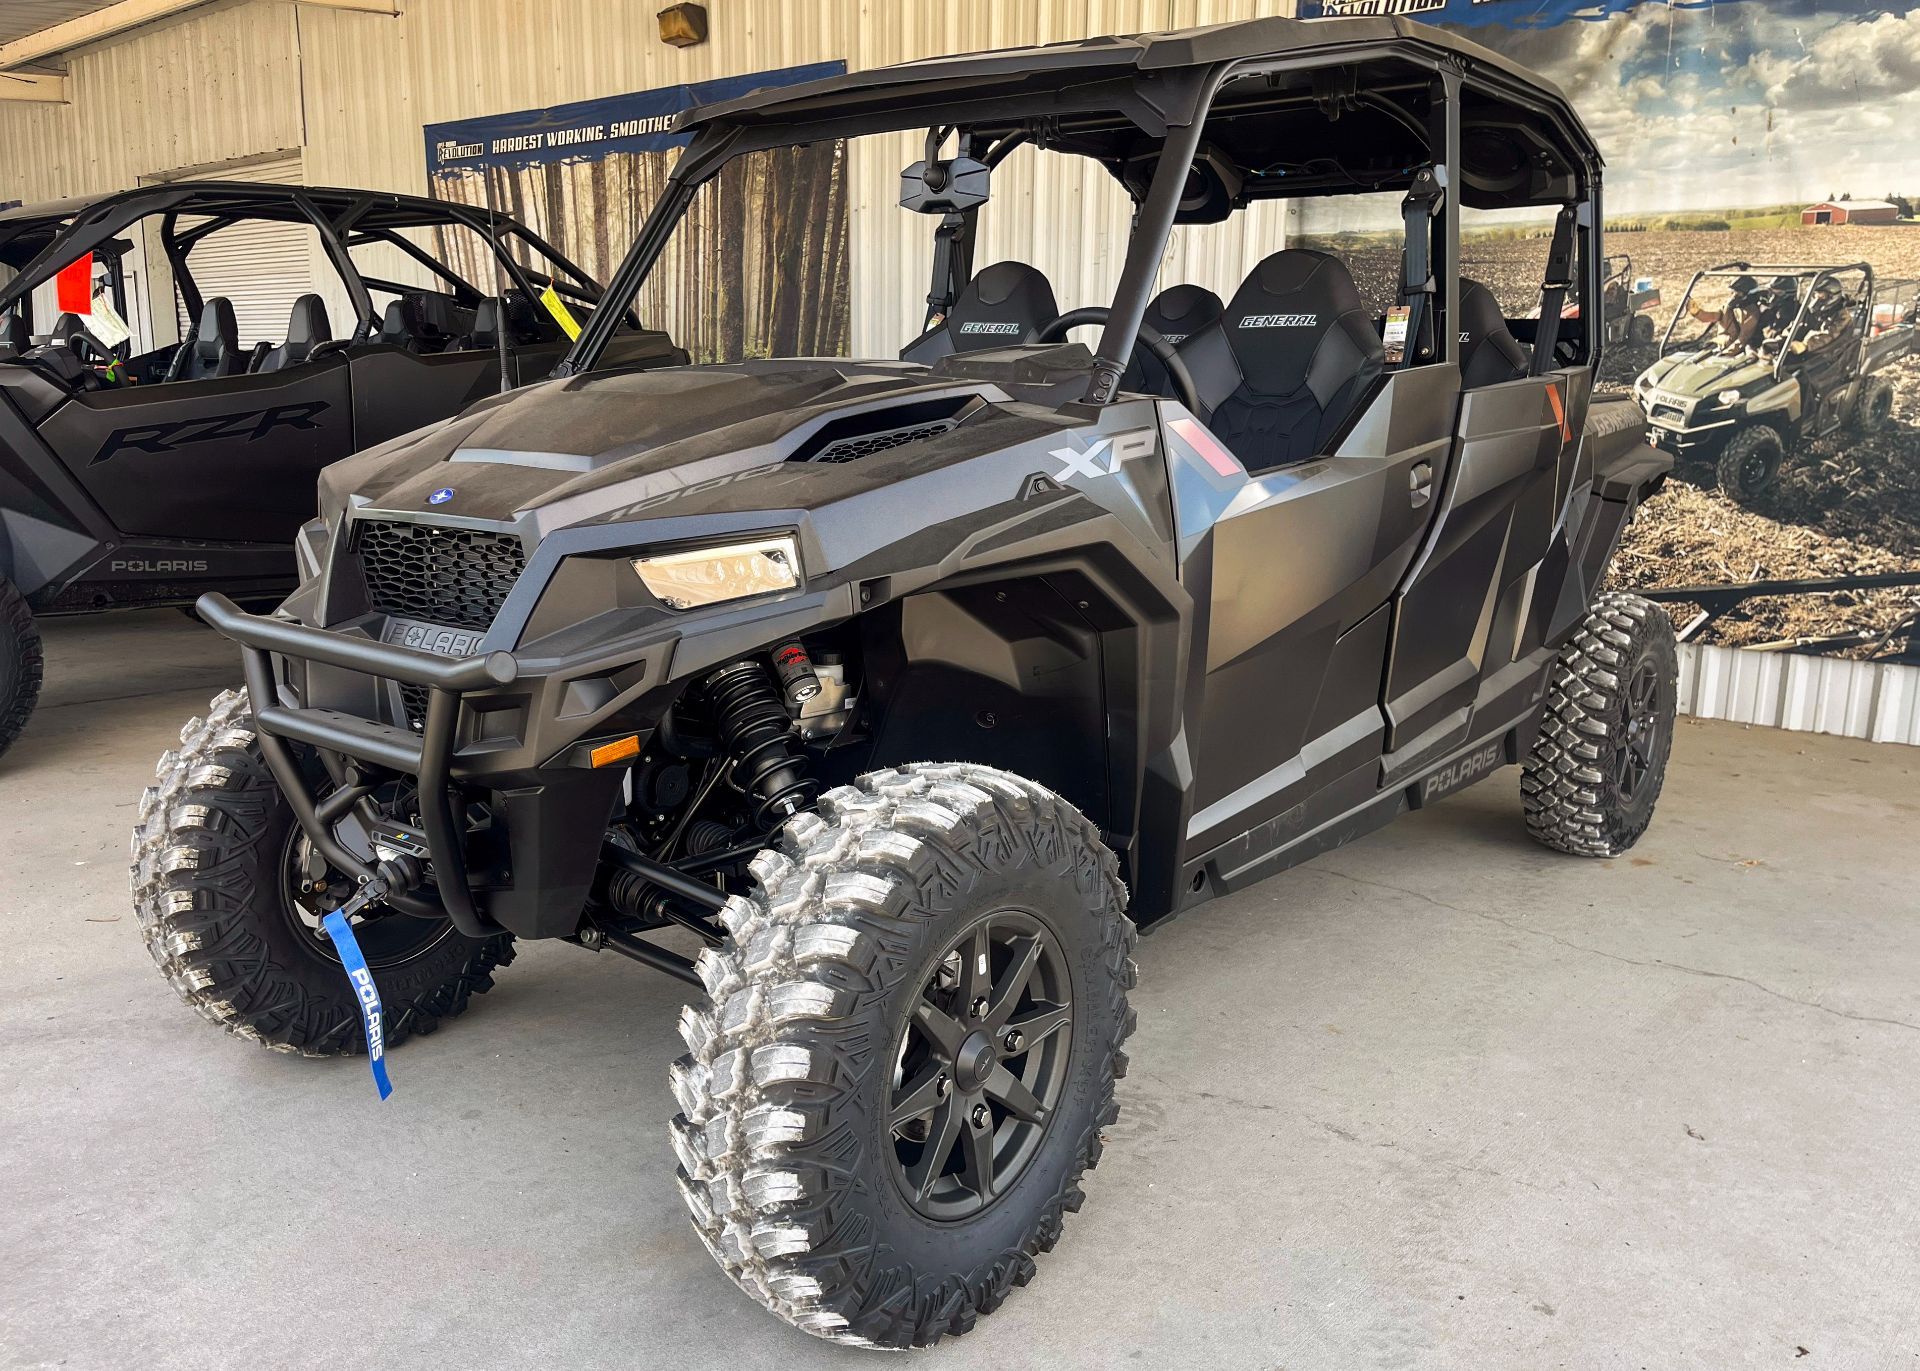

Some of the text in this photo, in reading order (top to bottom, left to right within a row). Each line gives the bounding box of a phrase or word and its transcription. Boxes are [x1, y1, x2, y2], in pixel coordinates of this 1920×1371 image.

[437, 143, 484, 165] REVOLUTION
[492, 133, 543, 154] HARDEST
[547, 125, 607, 147] WORKING.
[960, 322, 1019, 335] GENERAL
[1239, 315, 1317, 328] GENERAL
[88, 401, 331, 466] RZR
[1048, 428, 1157, 483] XP
[111, 560, 208, 572] POLARIS
[1424, 744, 1498, 800] POLARIS
[351, 967, 384, 1062] POLARIS
